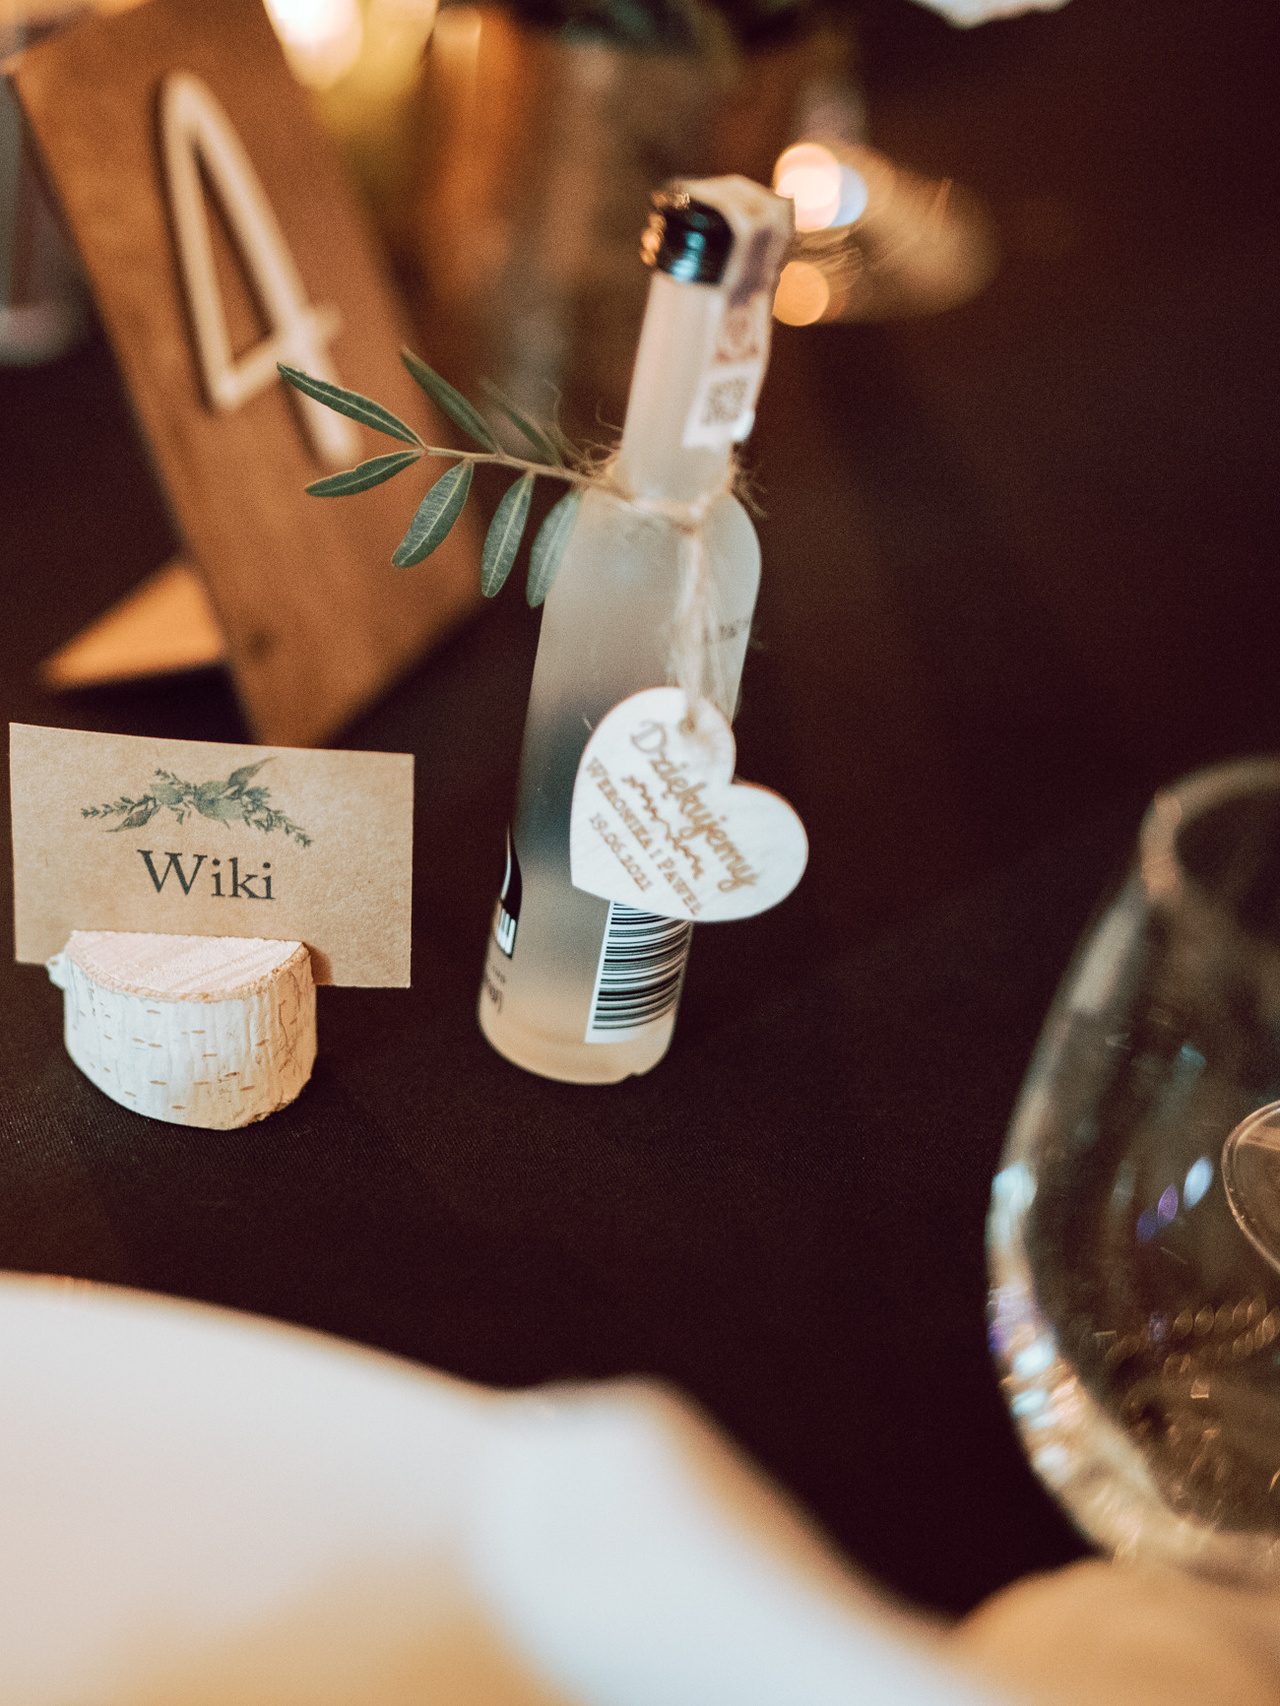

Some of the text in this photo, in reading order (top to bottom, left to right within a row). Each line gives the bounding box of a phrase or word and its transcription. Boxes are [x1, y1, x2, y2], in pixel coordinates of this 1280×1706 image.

[160, 70, 362, 468] 4
[586, 757, 654, 851] WERONIKA
[630, 718, 761, 893] Dziękujemy
[136, 848, 277, 901] Wiki
[589, 812, 654, 892] 19.06.2021
